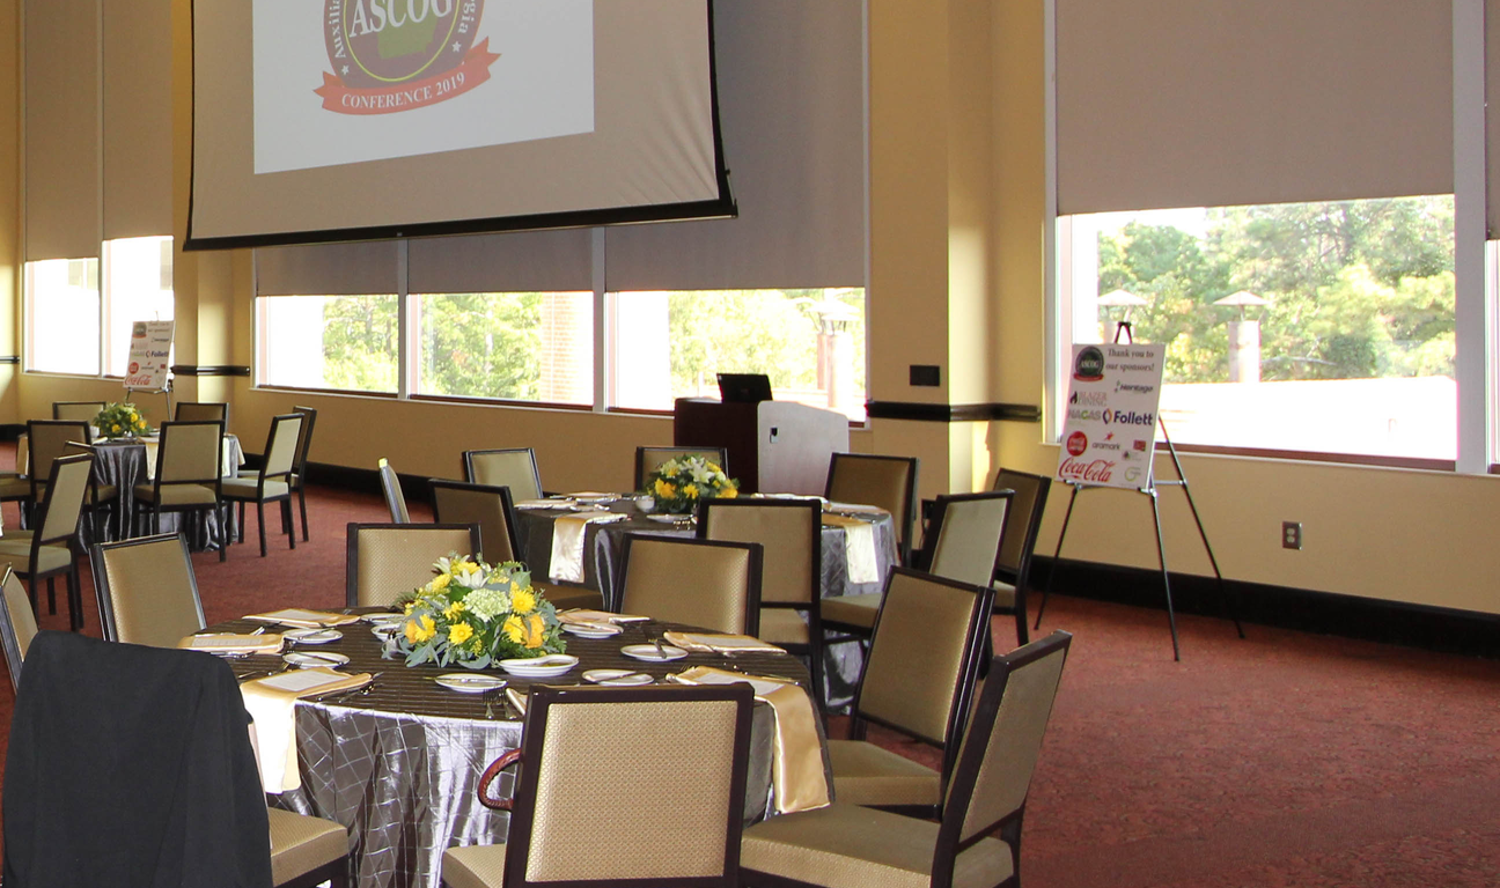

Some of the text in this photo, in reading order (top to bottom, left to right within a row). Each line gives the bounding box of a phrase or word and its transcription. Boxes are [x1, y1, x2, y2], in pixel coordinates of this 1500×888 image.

[342, 72, 465, 108] CONFERENCE 2019
[1108, 348, 1154, 359] Thank you to
[1120, 363, 1154, 373] sponsors!
[1114, 411, 1153, 425] Follett
[1092, 442, 1120, 450] aramark
